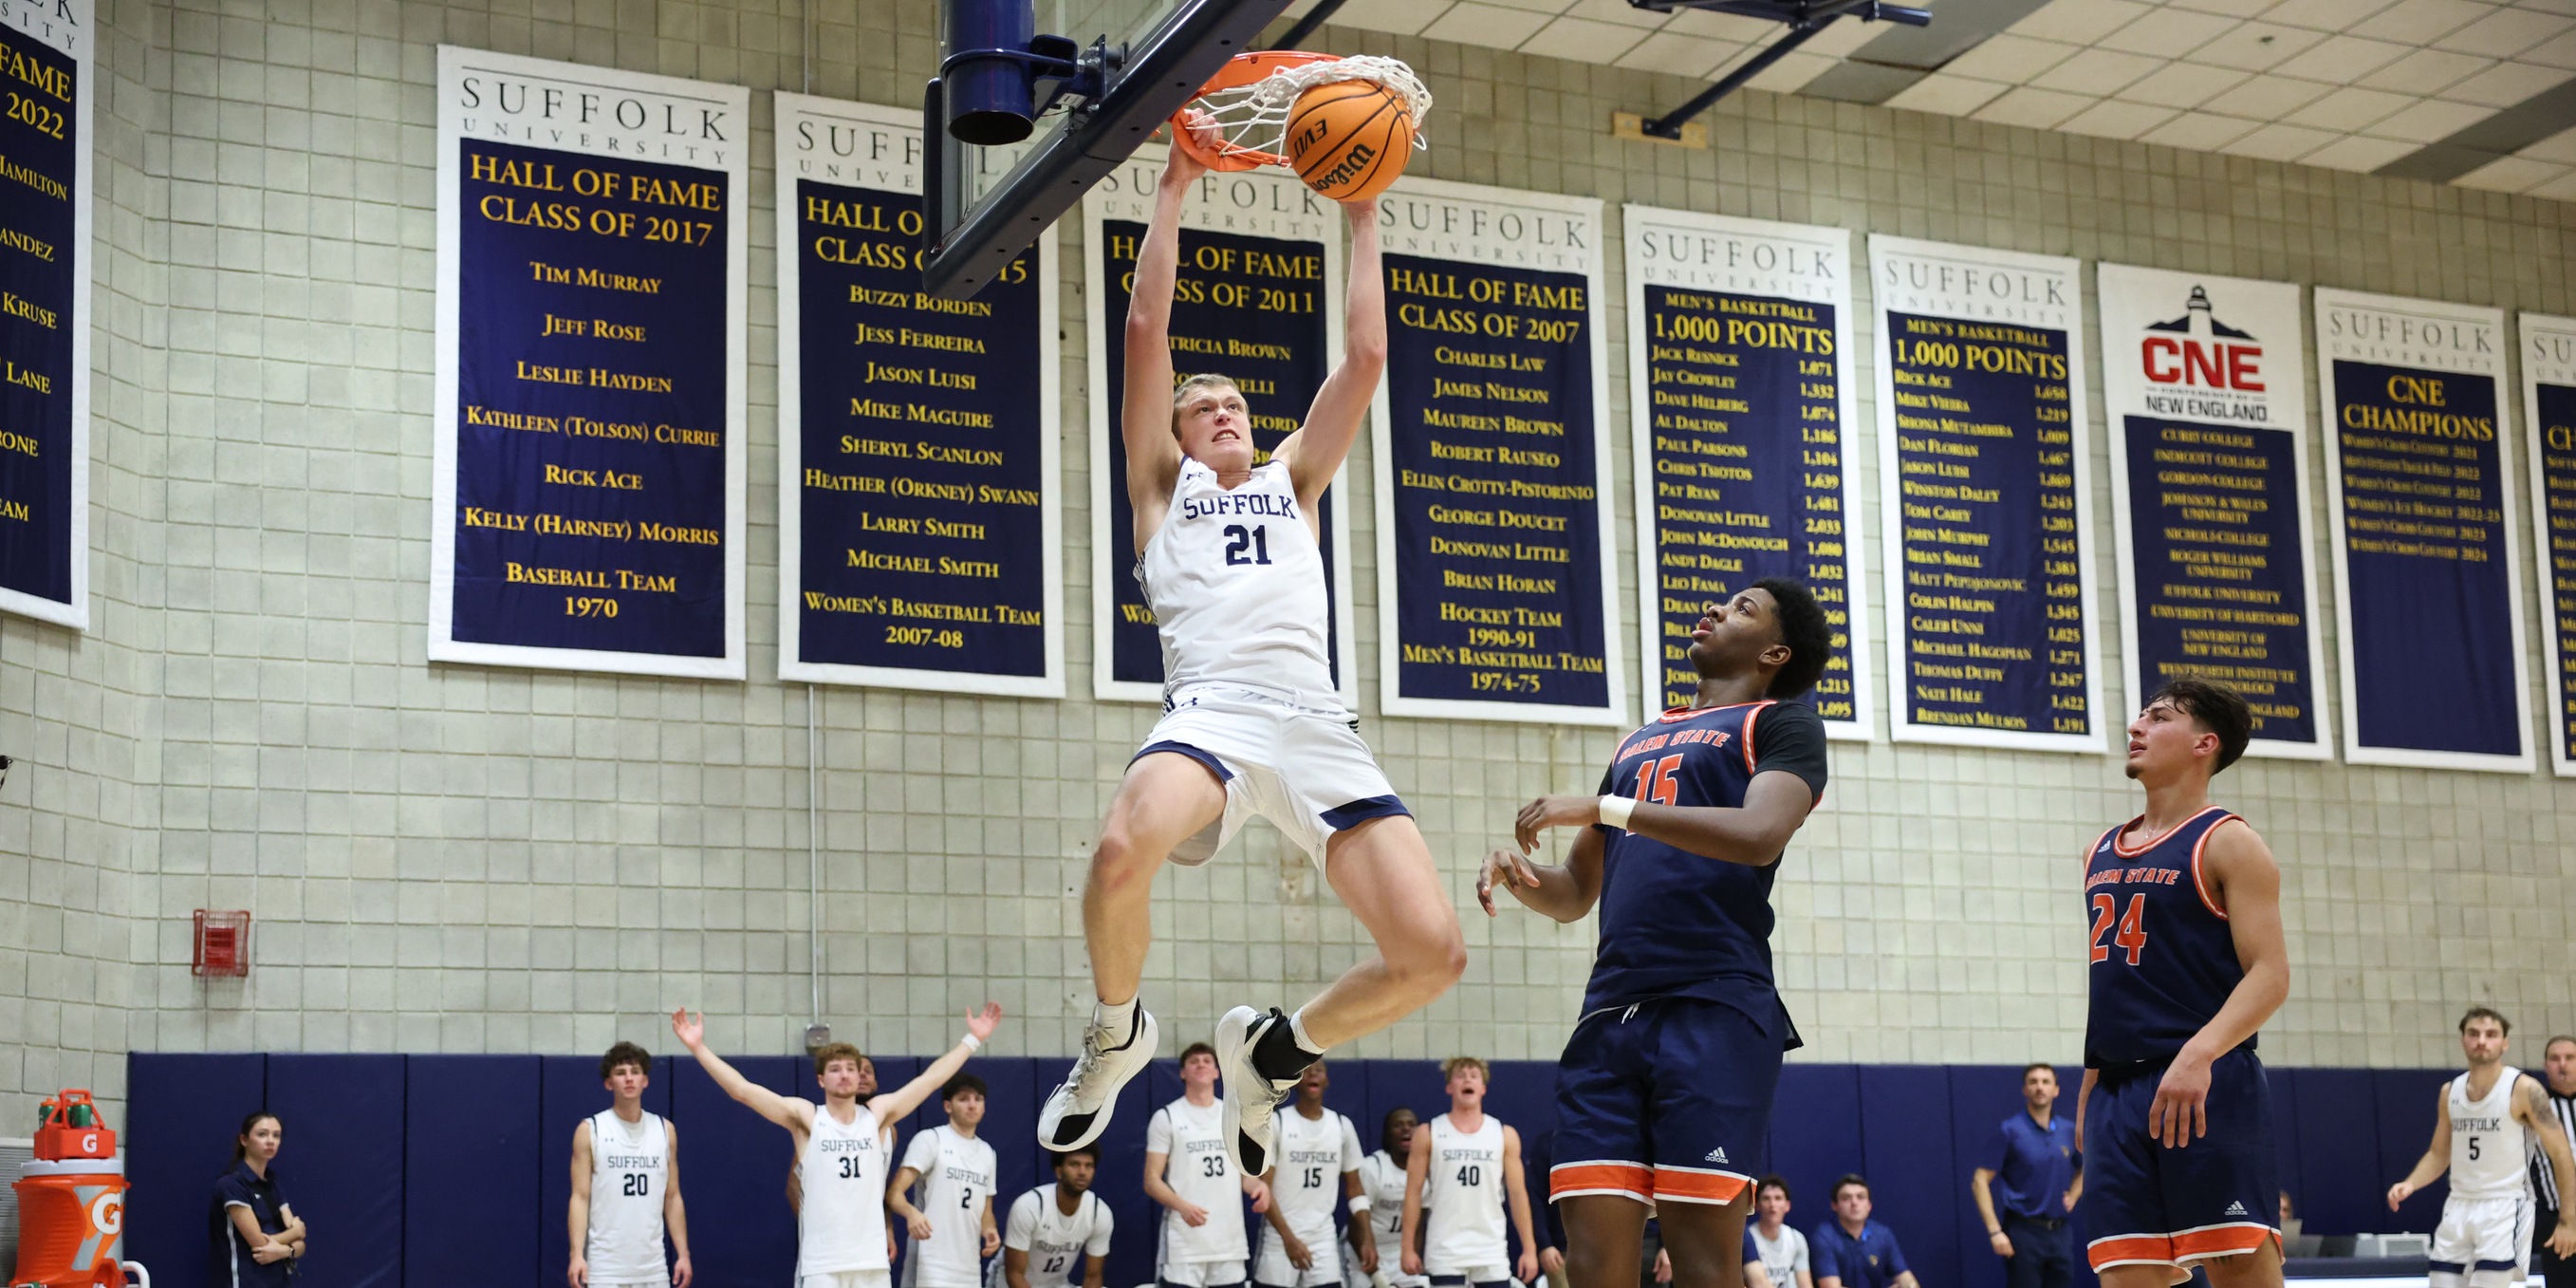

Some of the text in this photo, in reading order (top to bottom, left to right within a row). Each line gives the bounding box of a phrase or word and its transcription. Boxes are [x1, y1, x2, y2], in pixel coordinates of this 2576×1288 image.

[0, 43, 71, 103] FAME
[7, 92, 64, 140] 2022
[461, 77, 729, 141] SUFFOLK
[463, 118, 726, 164] UNIVERSITY
[470, 153, 721, 212] HALL OF FAME
[1307, 143, 1376, 192] Wilson
[480, 195, 713, 247] CLASS OF 2017
[806, 196, 923, 236] HALL O
[1380, 198, 1586, 250] SUFFOLK
[815, 236, 907, 270] CLASS
[1195, 245, 1322, 280] OF FAME
[1381, 234, 1586, 270] UNIVERSITY
[1642, 231, 1834, 279] SUFFOLK
[529, 260, 661, 293] TIM MURRAY
[1390, 268, 1585, 311] HALL OF FAME
[1644, 266, 1833, 298] UNIVERSITY
[1885, 258, 2066, 307] SUFFOLK
[2, 291, 57, 329] KRUSE
[849, 285, 991, 317] BUZZY BORDEN
[1212, 282, 1314, 313] OF 2011
[1665, 292, 1817, 323] MEN'S BASKETBALL
[542, 313, 646, 342] JEFF ROSE
[855, 323, 986, 354] JESS FERREIRA
[1399, 303, 1580, 345] CLASS OF 2007
[1655, 312, 1834, 356] 1,000 POINTS
[1957, 324, 2050, 348] BASKETBALL
[2329, 310, 2492, 354] SUFFOLK
[1228, 339, 1291, 361] BROWN
[1434, 345, 1547, 372] CHARLES LAW
[1897, 339, 2067, 381] 1,000 POINTS
[2140, 336, 2267, 393] CNE
[6, 361, 51, 395] LANE
[516, 361, 672, 393] LESLIE HAYDEN
[864, 361, 976, 389] JASON LUISI
[1433, 378, 1549, 403] JAMES NELSON
[2386, 374, 2446, 407] CNE
[850, 398, 993, 429] MIKE MAGUIRE
[2145, 395, 2269, 423] NEW ENGLAND
[2343, 403, 2493, 441] CHAMPIONS
[467, 405, 720, 447] KATHLEEN (TOLSON) CURRIE
[841, 435, 1003, 466] SHERYL SCANLON
[1430, 440, 1494, 462] ROBERT
[545, 464, 643, 491] RICK ACE
[805, 468, 1039, 506] HEATHER (ORKNEY) SWANN
[1183, 494, 1296, 520] SUFFOLK
[1428, 504, 1494, 526] GEORGE
[465, 508, 719, 545] KELLY (HARNEY) MORRIS
[861, 512, 985, 540] LARRY SMITH
[1223, 524, 1273, 567] 21
[1430, 536, 1570, 564] DONOVAN LITTLE
[506, 562, 676, 593] BASEBALL TEAM
[846, 548, 999, 579] MICHAEL SMITH
[1443, 569, 1556, 594] BRIAN HORAN
[565, 596, 619, 618] 1970
[805, 591, 1042, 625] WOMEN'S BASKETBALL TEAM
[1440, 602, 1563, 628] HOCKEY TEAM
[885, 625, 964, 648] 2007-08
[1468, 627, 1535, 649] 1990-91
[1458, 646, 1556, 670] BASKETBALL
[1558, 652, 1603, 674] TEAM
[1470, 672, 1541, 693] 1974-75
[1670, 729, 1731, 748] STATE
[1630, 753, 1684, 822] 15
[2124, 868, 2180, 886] STATE
[2090, 892, 2147, 965] 24
[83, 1134, 98, 1153] G
[821, 1137, 873, 1152] SUFFOLK
[1186, 1140, 1226, 1153] SUFFOL
[1289, 1150, 1338, 1164] SUFFOLK
[1442, 1148, 1495, 1162] SUFFOLK
[2469, 1137, 2480, 1160] 5
[608, 1156, 660, 1169] SUFFOLK
[839, 1156, 861, 1179] 31
[1203, 1156, 1224, 1177] 33
[1705, 1155, 1728, 1164] adidas
[623, 1173, 648, 1196] 20
[947, 1167, 989, 1187] SUFFOLK
[1303, 1167, 1323, 1188] 15
[1457, 1166, 1480, 1186] 40
[92, 1192, 121, 1234] G
[961, 1187, 972, 1208] 2
[1044, 1256, 1065, 1273] 12
